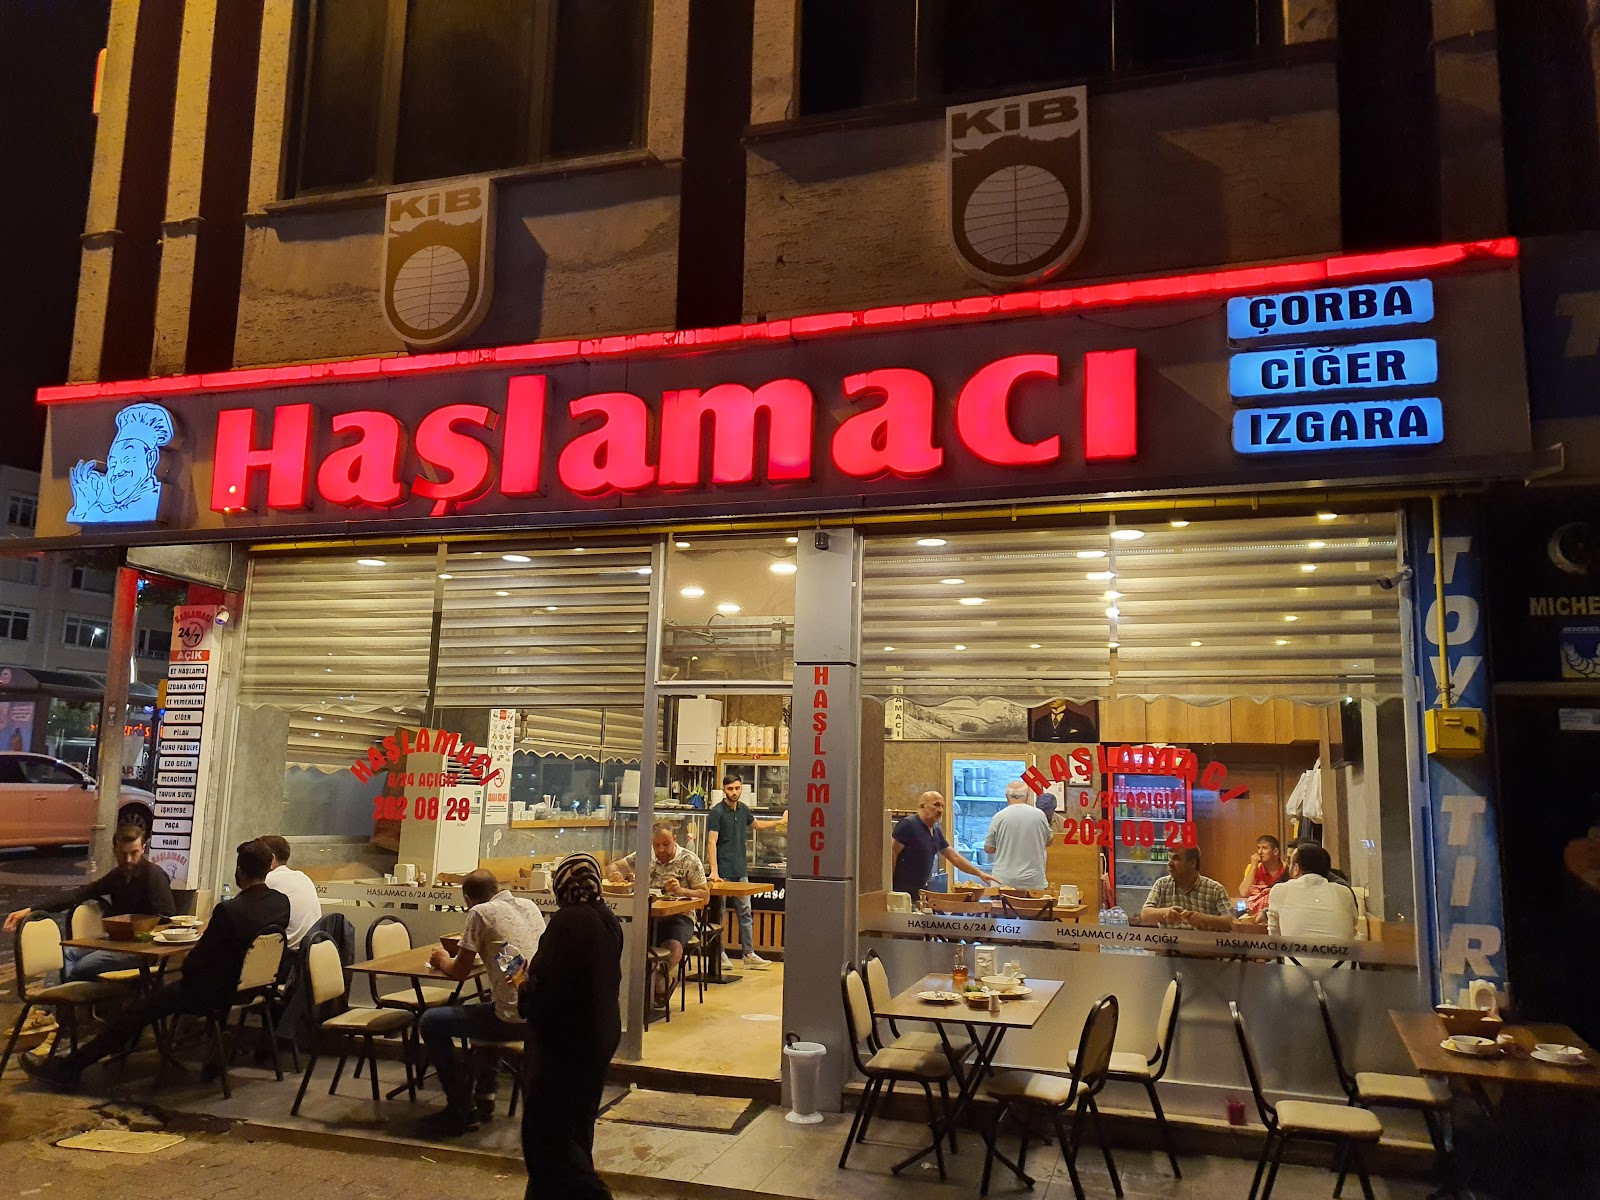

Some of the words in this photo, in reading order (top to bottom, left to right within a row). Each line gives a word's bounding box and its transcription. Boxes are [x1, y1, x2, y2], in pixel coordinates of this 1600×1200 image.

[1249, 285, 1413, 334] ÇORBA
[1260, 346, 1407, 390] CİĞER
[209, 346, 1138, 518] Haşlamacı
[1249, 405, 1429, 445] IZGARA
[177, 627, 201, 644] 24/7
[176, 650, 203, 661] AÇIK
[350, 728, 501, 787] HAŞLAMACI
[806, 666, 830, 876] HAŞLAMACI
[1020, 744, 1249, 803] HAŞLAMACI
[372, 795, 408, 820] 202
[414, 796, 439, 821] 08
[445, 797, 470, 821] 28
[1063, 818, 1111, 846] 202
[1121, 819, 1155, 848] 08
[1164, 821, 1198, 849] 28
[366, 888, 407, 898] HAŞLAMACI
[408, 890, 426, 899] 6/24
[427, 890, 452, 900] AÇIĞIZ
[907, 918, 962, 931] HAŞLAMACI
[963, 922, 987, 933] 6/24
[989, 923, 1022, 935] AÇIĞIZ
[1056, 927, 1115, 940] HAŞLAMACI
[1116, 931, 1142, 942] 6/24
[1144, 932, 1180, 944] AÇIĞIZ
[1215, 938, 1278, 951] HAŞLAMACI
[1280, 942, 1308, 953] 6/24
[1310, 943, 1349, 956] AÇIĞIZ
